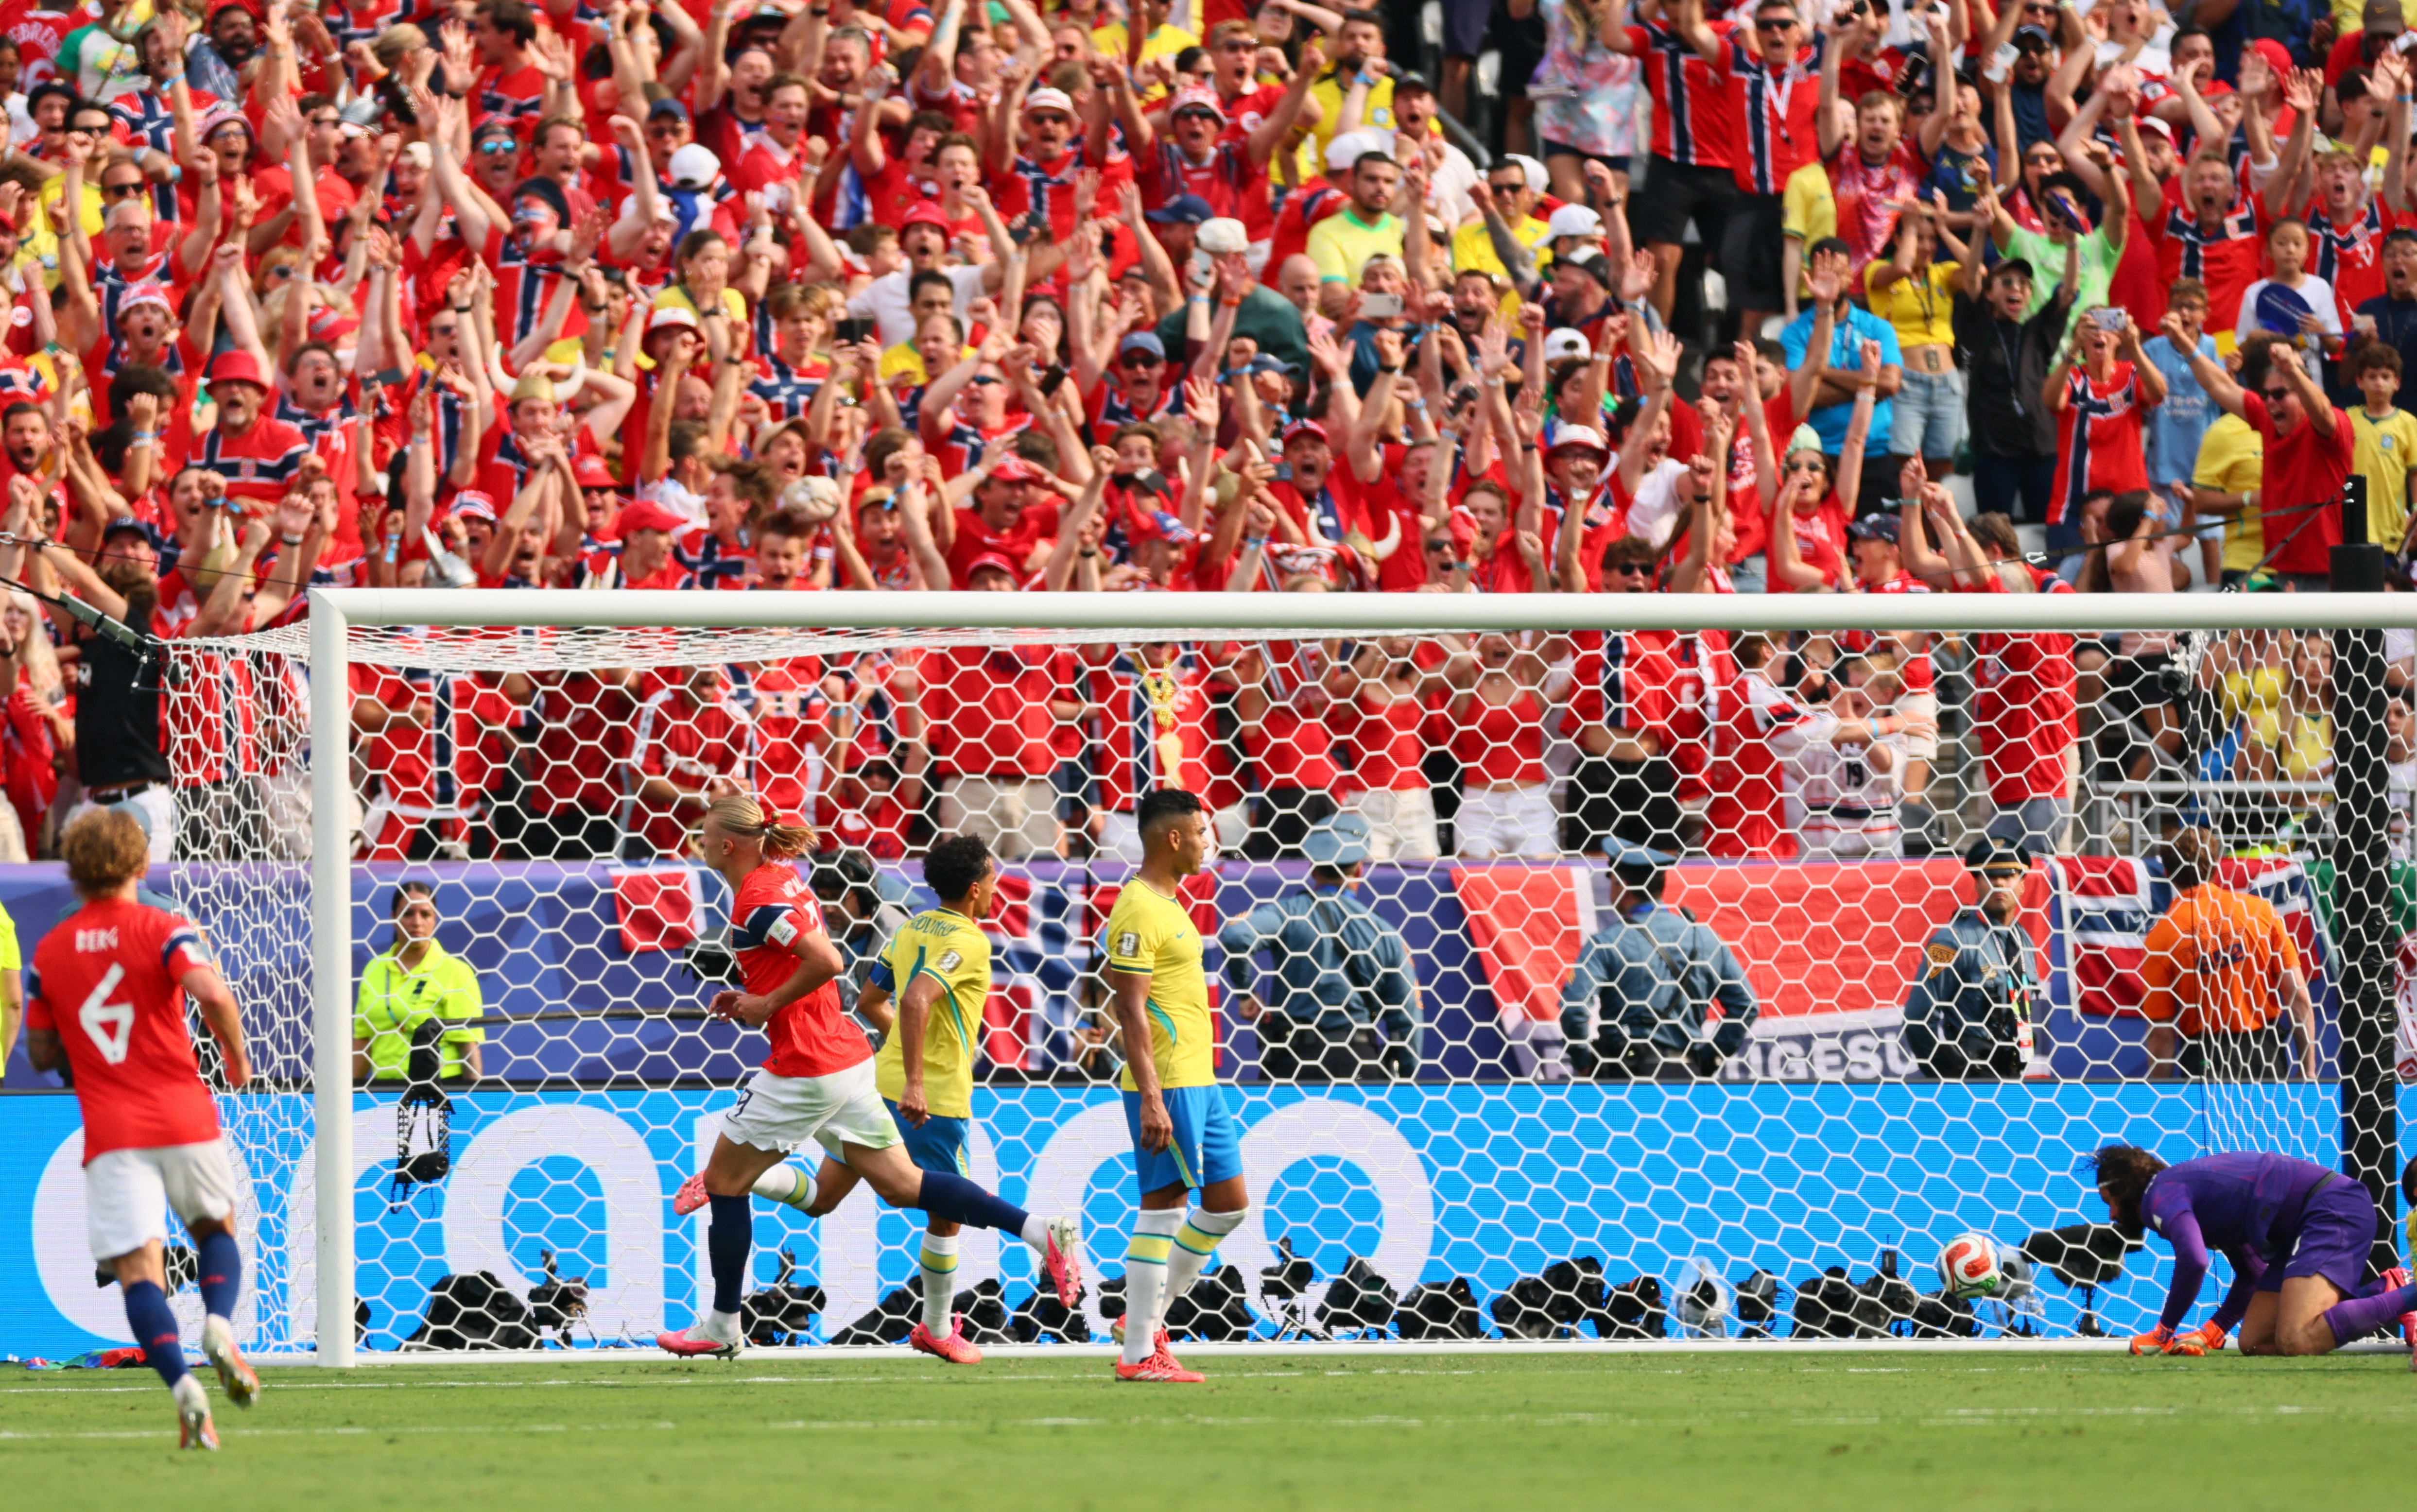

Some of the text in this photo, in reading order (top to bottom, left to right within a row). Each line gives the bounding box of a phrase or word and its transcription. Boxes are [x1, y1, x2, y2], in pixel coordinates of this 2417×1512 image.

[75, 925, 119, 954] BERG
[78, 961, 135, 1065] 6
[737, 1088, 754, 1118] 9
